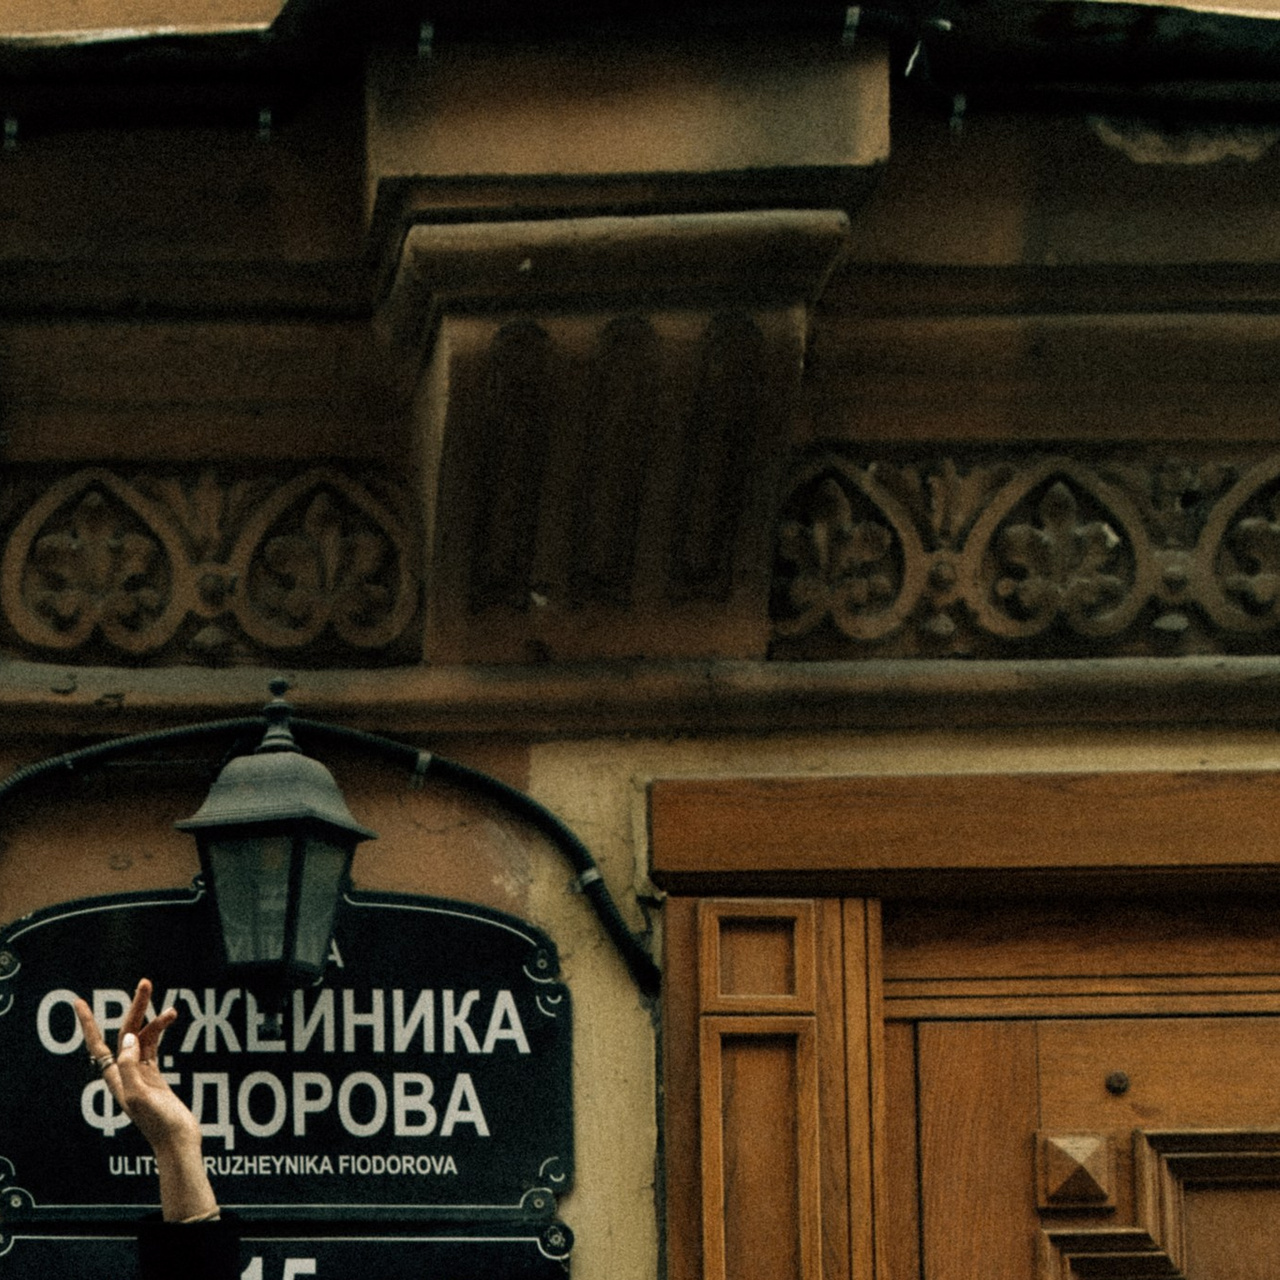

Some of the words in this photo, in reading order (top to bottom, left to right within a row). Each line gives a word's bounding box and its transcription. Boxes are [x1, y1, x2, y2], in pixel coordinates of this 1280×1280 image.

[81, 1053, 491, 1150] ФДОРОВА
[109, 1155, 161, 1176] ULIT
[202, 1155, 334, 1176] RUZHEYNIKA
[338, 1155, 459, 1176] FIODOROVA
